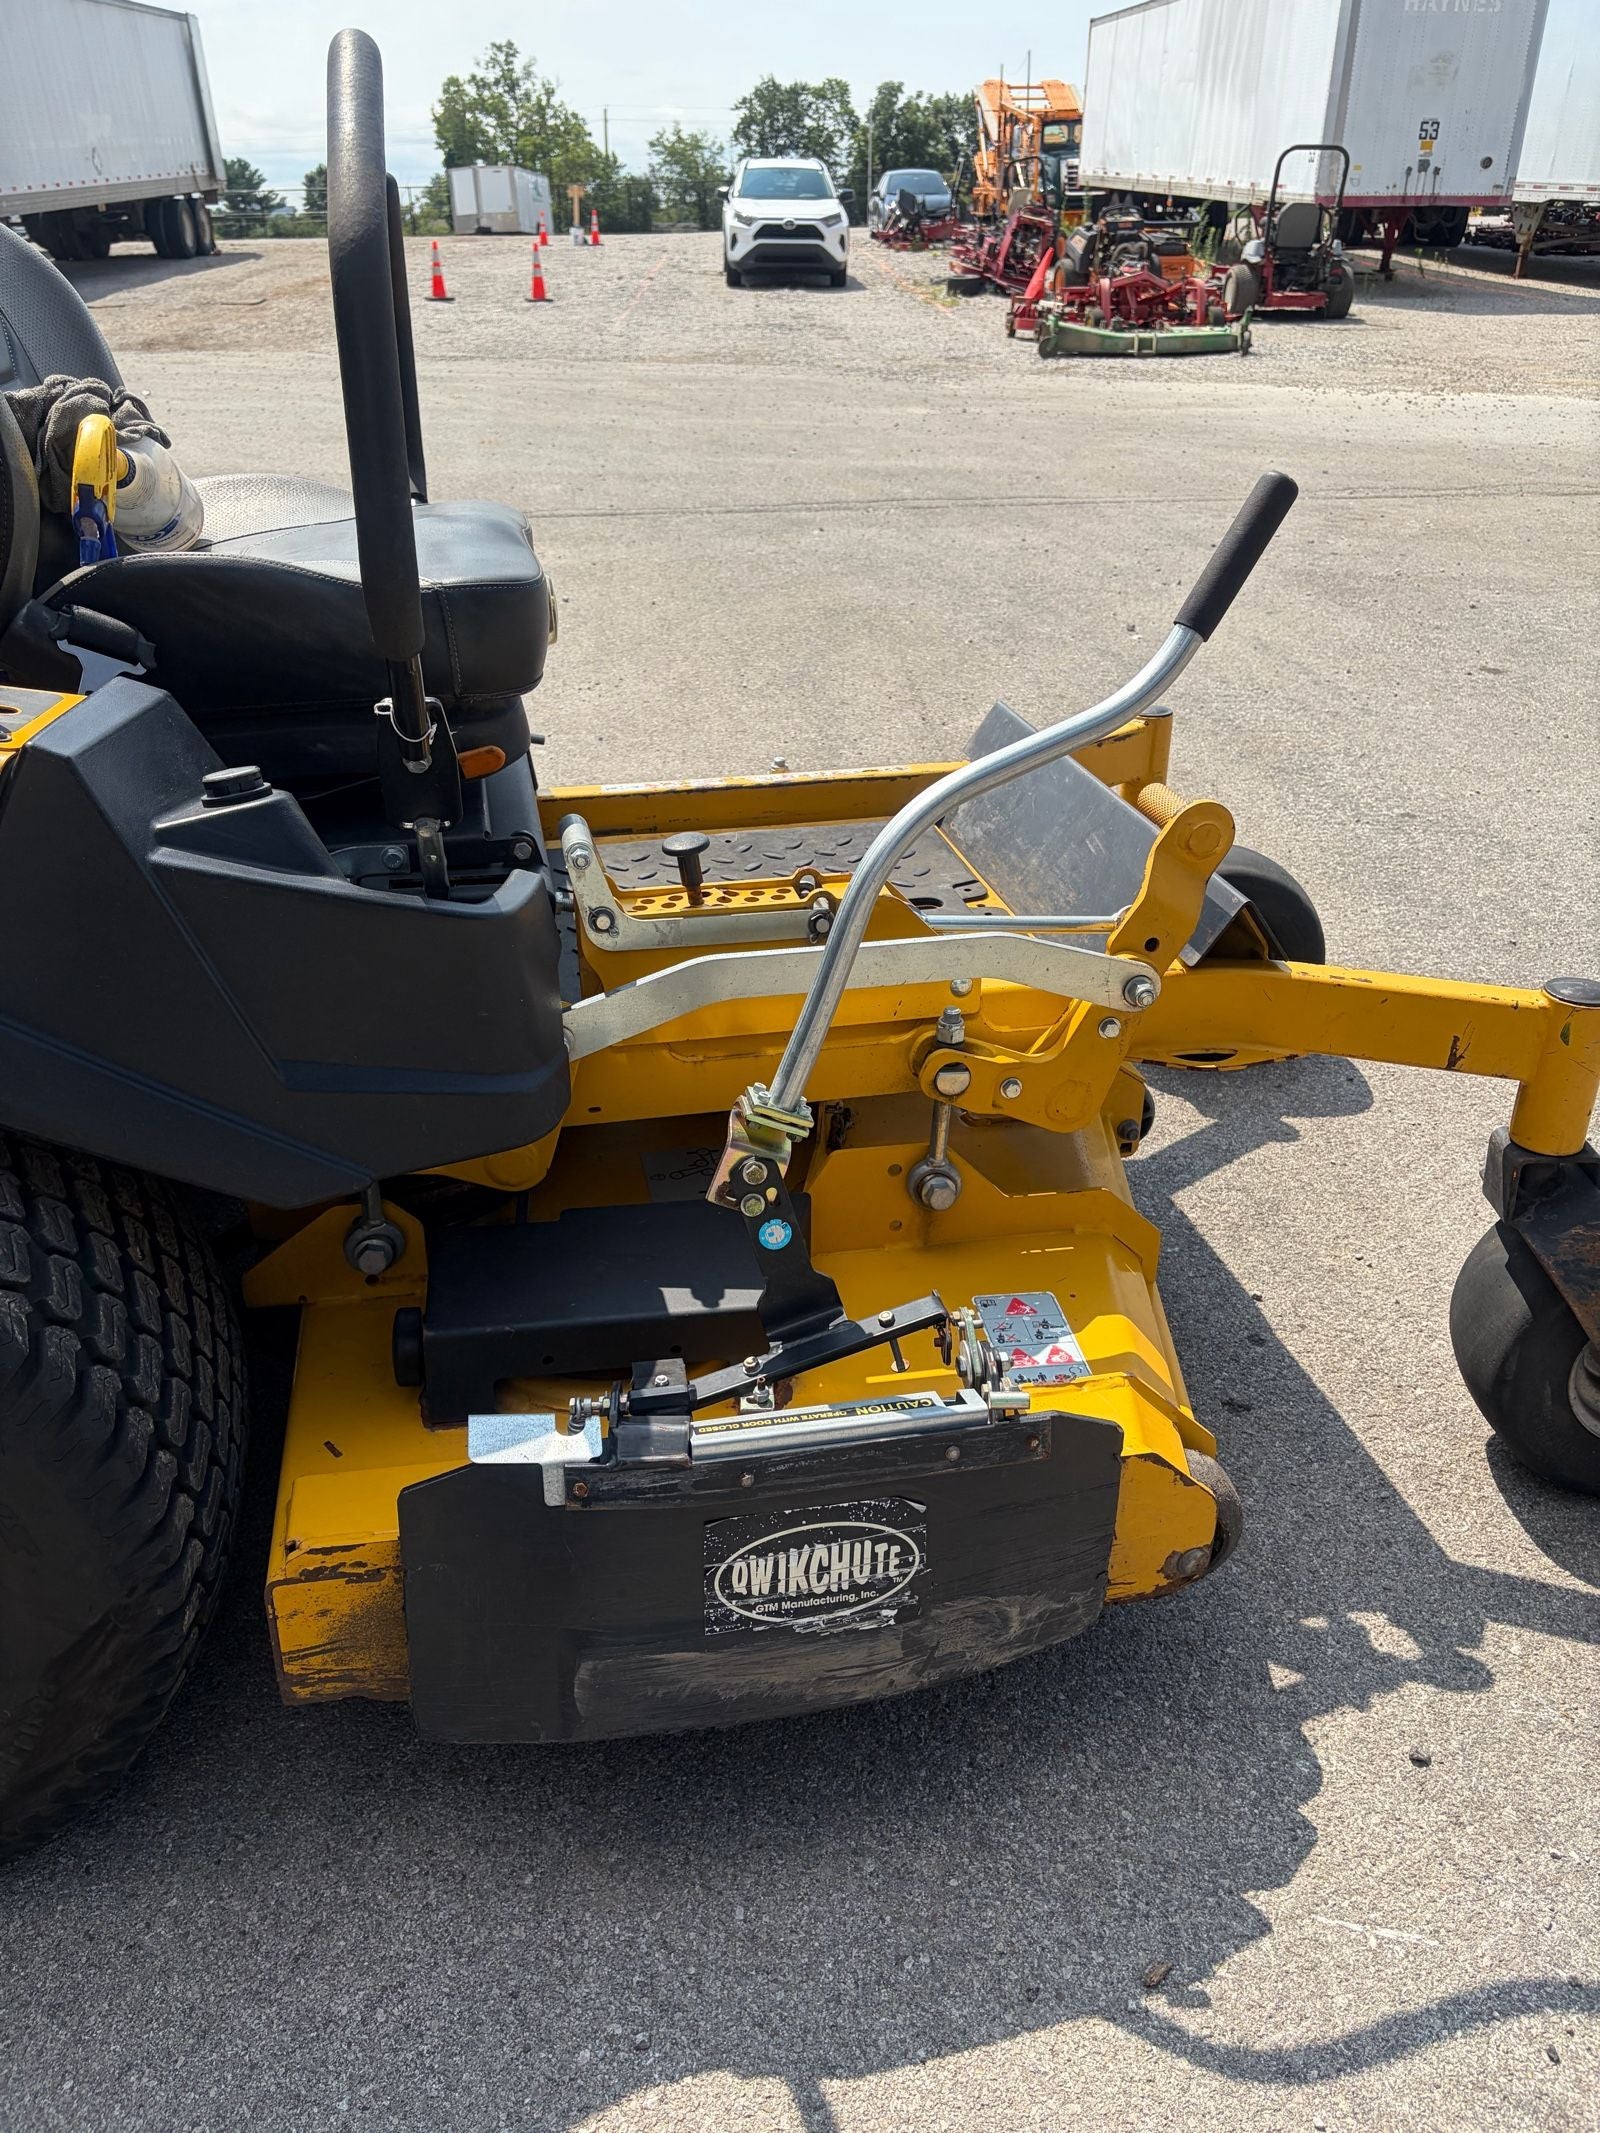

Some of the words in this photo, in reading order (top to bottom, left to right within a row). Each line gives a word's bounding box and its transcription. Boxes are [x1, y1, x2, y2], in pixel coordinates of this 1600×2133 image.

[1404, 0, 1501, 12] HAYNES
[1418, 121, 1440, 140] 53
[855, 1399, 932, 1416] CAUTION
[774, 1416, 799, 1424] WITH
[801, 1411, 847, 1420] OPERATE
[698, 1423, 740, 1433] CLOSED
[742, 1420, 772, 1428] DOOR
[732, 1540, 901, 1597] QWIKCHUTE
[755, 1602, 779, 1614] GTM
[781, 1593, 859, 1611] Manufacturing,
[860, 1590, 880, 1599] Inc.
